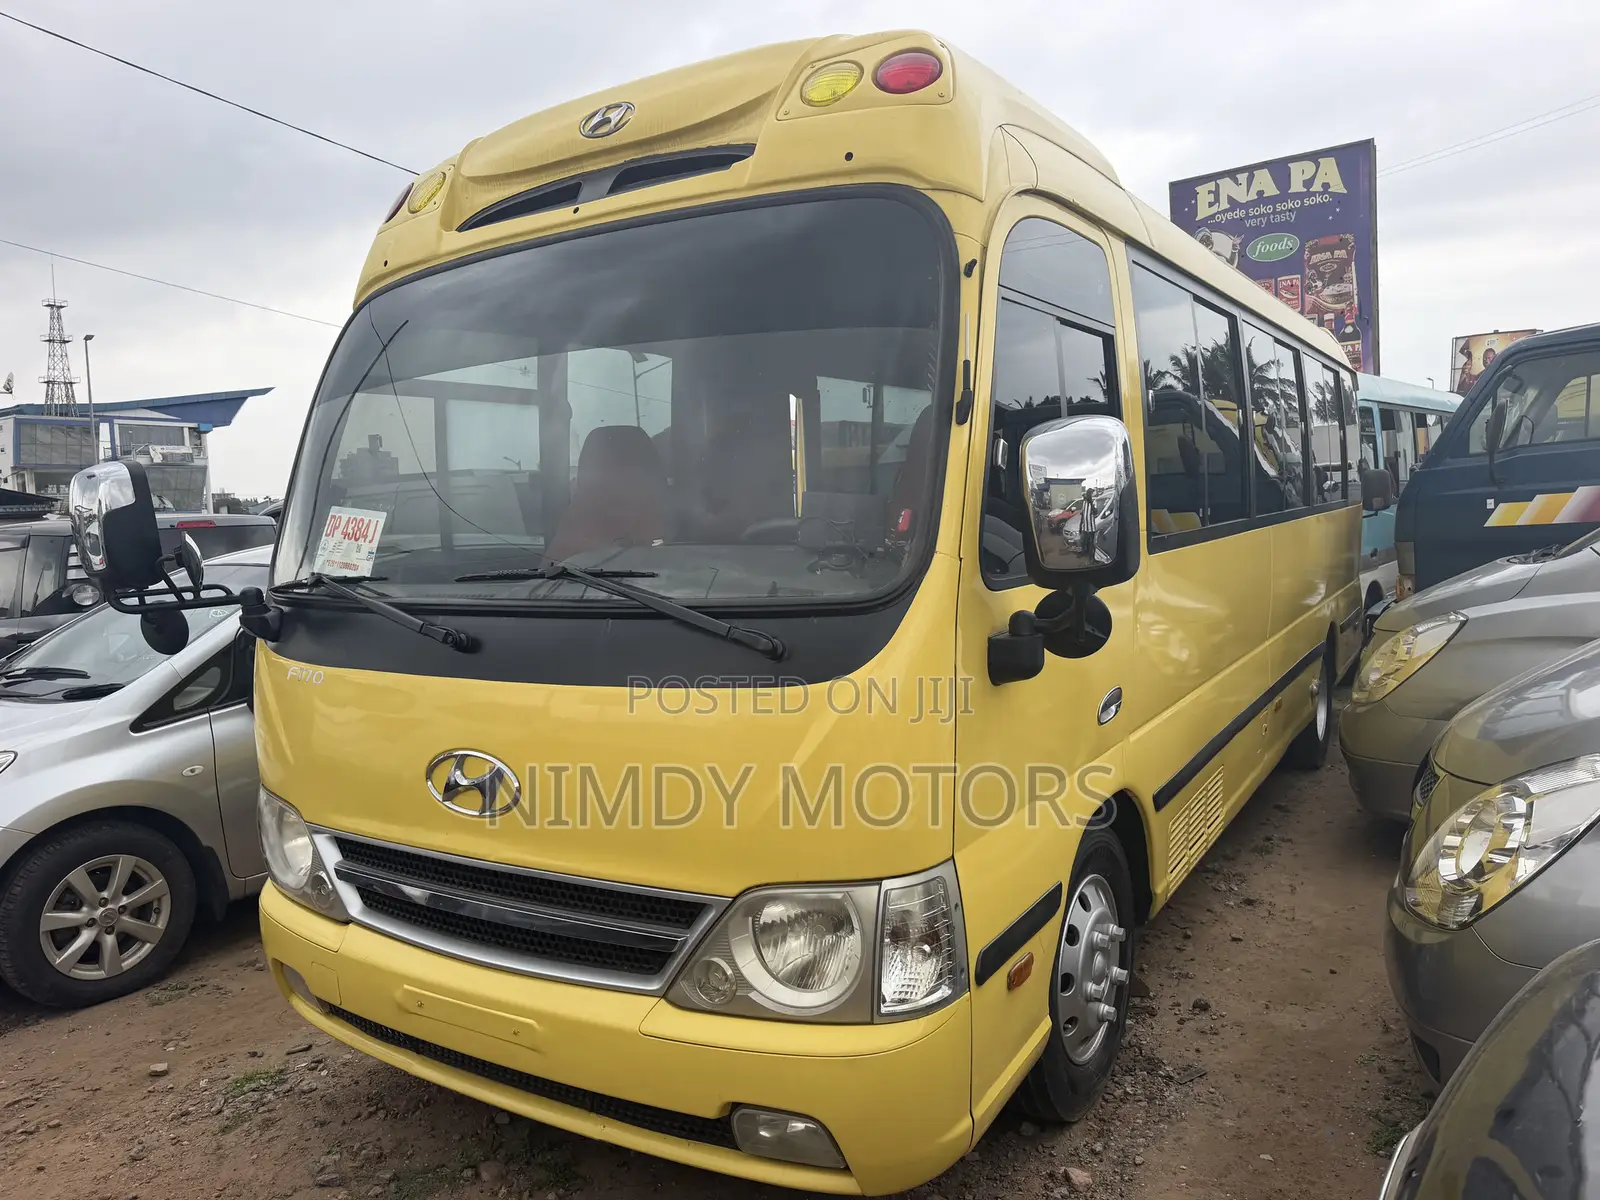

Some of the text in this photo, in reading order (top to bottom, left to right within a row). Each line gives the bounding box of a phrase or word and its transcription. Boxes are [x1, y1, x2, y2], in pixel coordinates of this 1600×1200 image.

[1195, 157, 1348, 221] ENA PA
[1248, 203, 1273, 217] soko
[1275, 197, 1301, 212] soko
[1303, 192, 1333, 207] soko.
[1244, 210, 1297, 228] very tasty
[1253, 237, 1294, 258] foods
[325, 514, 379, 544] DP 4384 J
